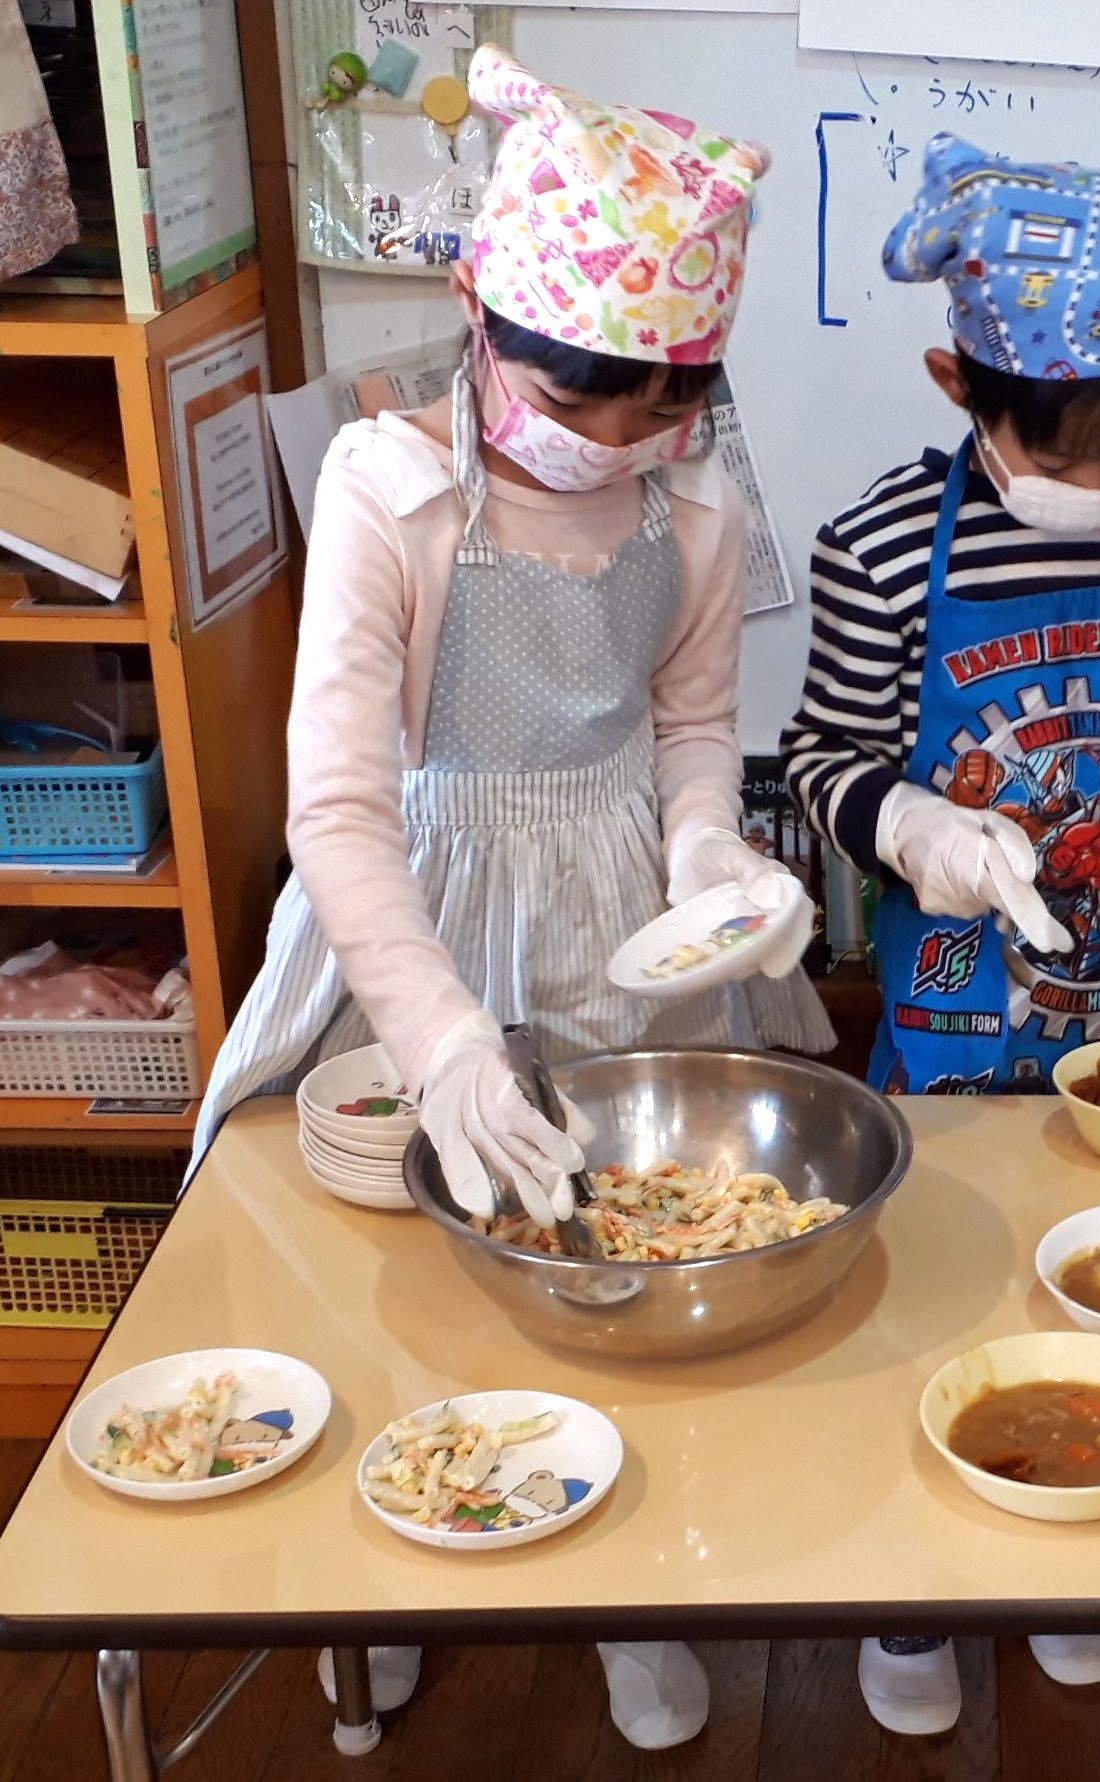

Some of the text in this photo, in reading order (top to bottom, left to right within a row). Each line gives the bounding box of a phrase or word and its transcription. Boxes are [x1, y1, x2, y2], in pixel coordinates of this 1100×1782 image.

[928, 78, 1036, 113] うがい
[451, 187, 473, 209] ほ
[943, 629, 1041, 688] KAMEN
[971, 1013, 1000, 1034] FORM
